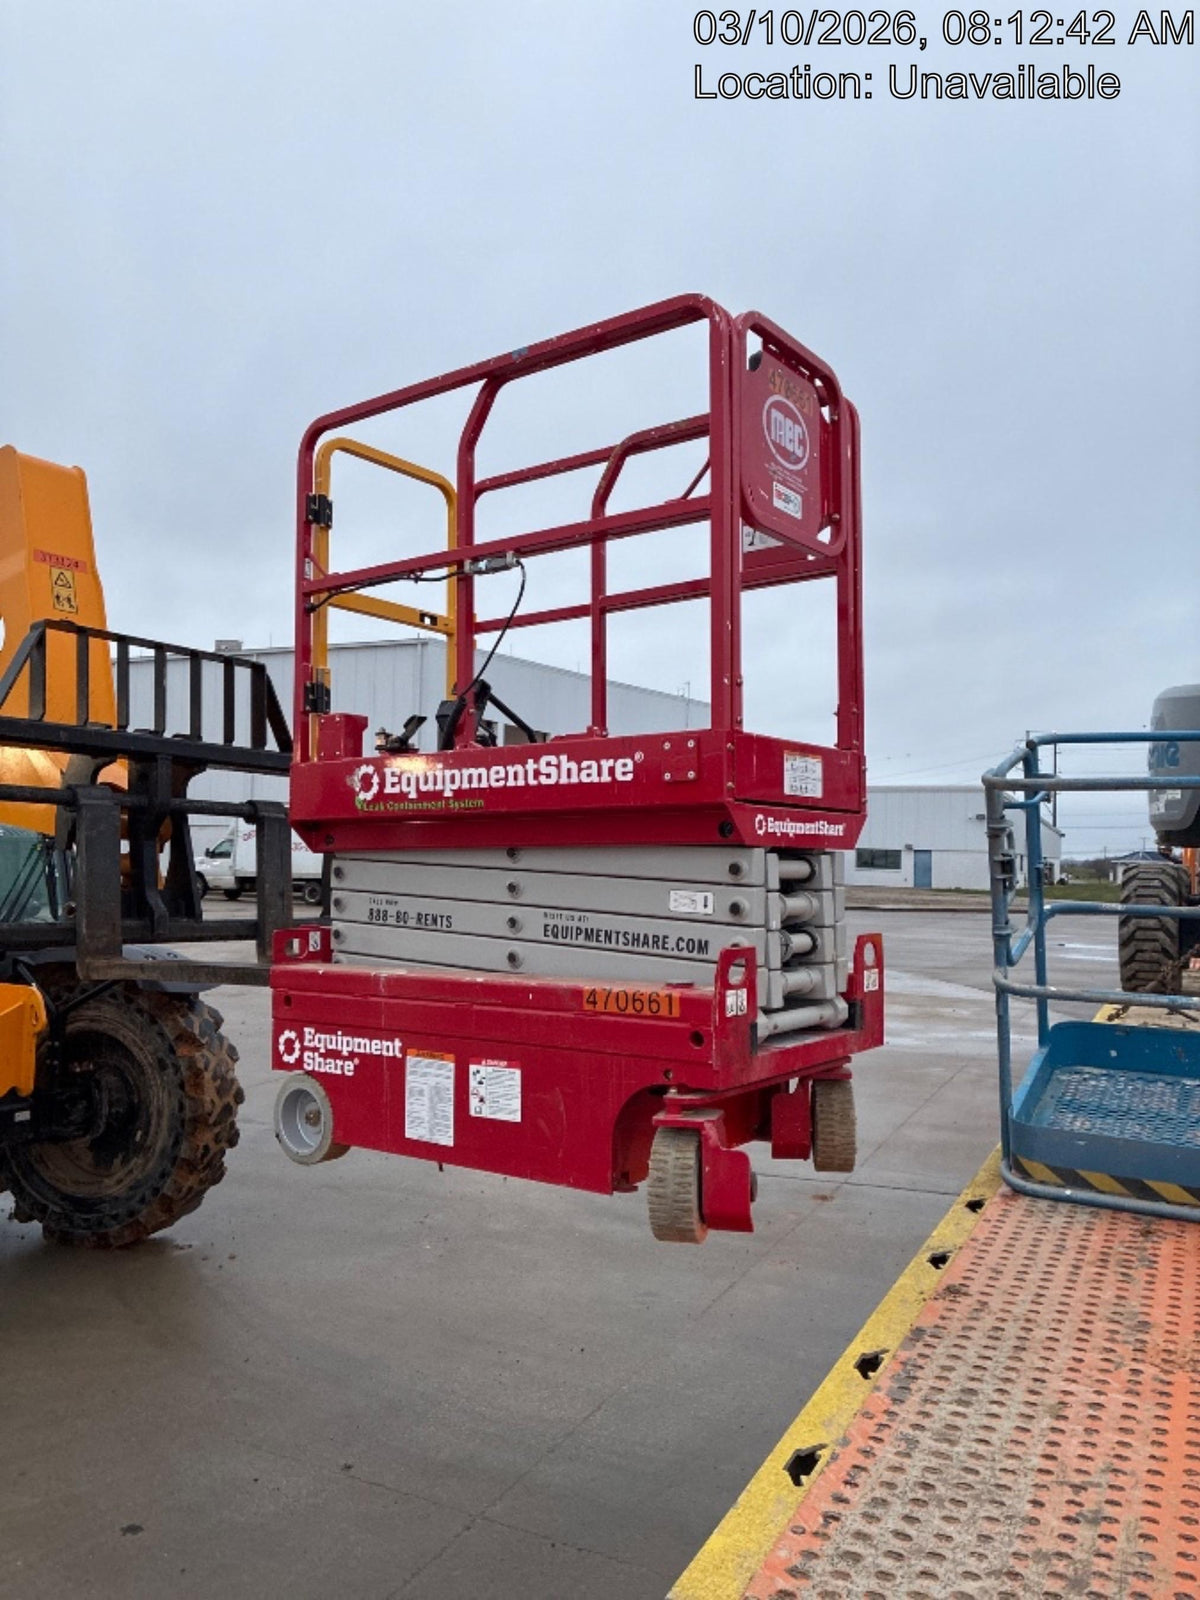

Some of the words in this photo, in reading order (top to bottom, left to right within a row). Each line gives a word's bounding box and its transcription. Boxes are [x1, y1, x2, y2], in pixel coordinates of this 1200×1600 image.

[543, 923, 710, 955] EQUIPMENTSHARE.COM
[586, 988, 673, 1016] 470661
[303, 1027, 403, 1058] Equipment
